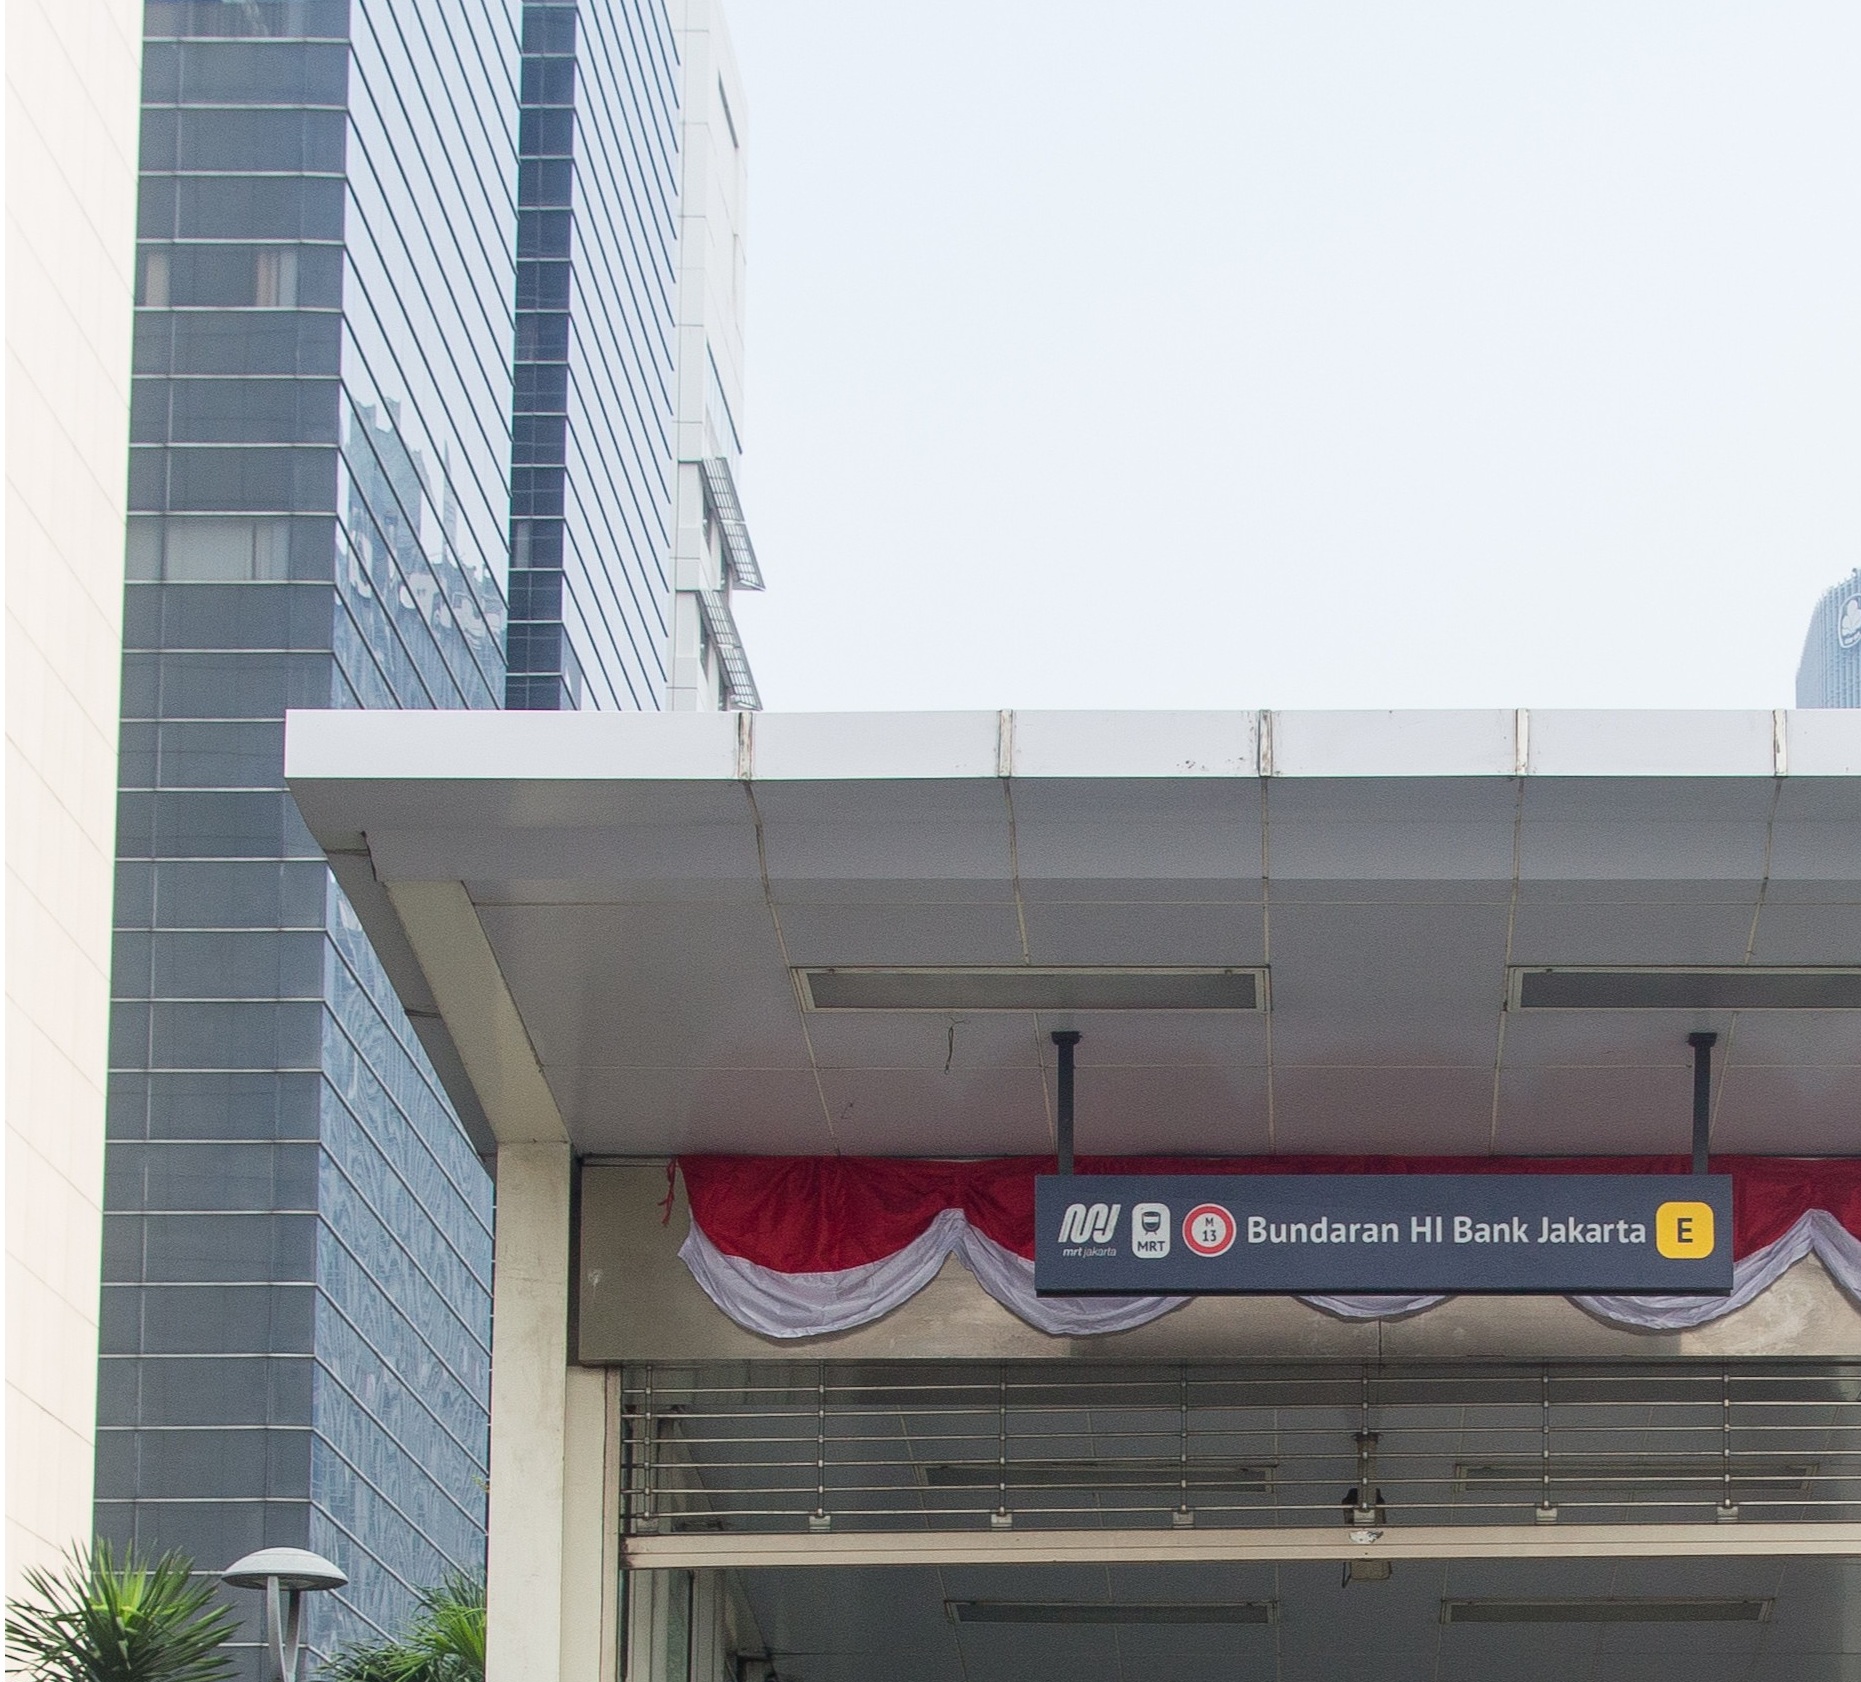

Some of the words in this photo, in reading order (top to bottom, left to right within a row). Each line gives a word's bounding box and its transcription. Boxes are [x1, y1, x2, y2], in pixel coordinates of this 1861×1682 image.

[1204, 1217, 1214, 1227] M
[1201, 1229, 1218, 1242] 13
[1246, 1215, 1400, 1244] Bundaran
[1410, 1217, 1443, 1244] HI
[1453, 1215, 1529, 1244] Bank
[1536, 1215, 1647, 1244] Jakarta
[1677, 1218, 1694, 1242] E
[1137, 1240, 1165, 1253] MRT
